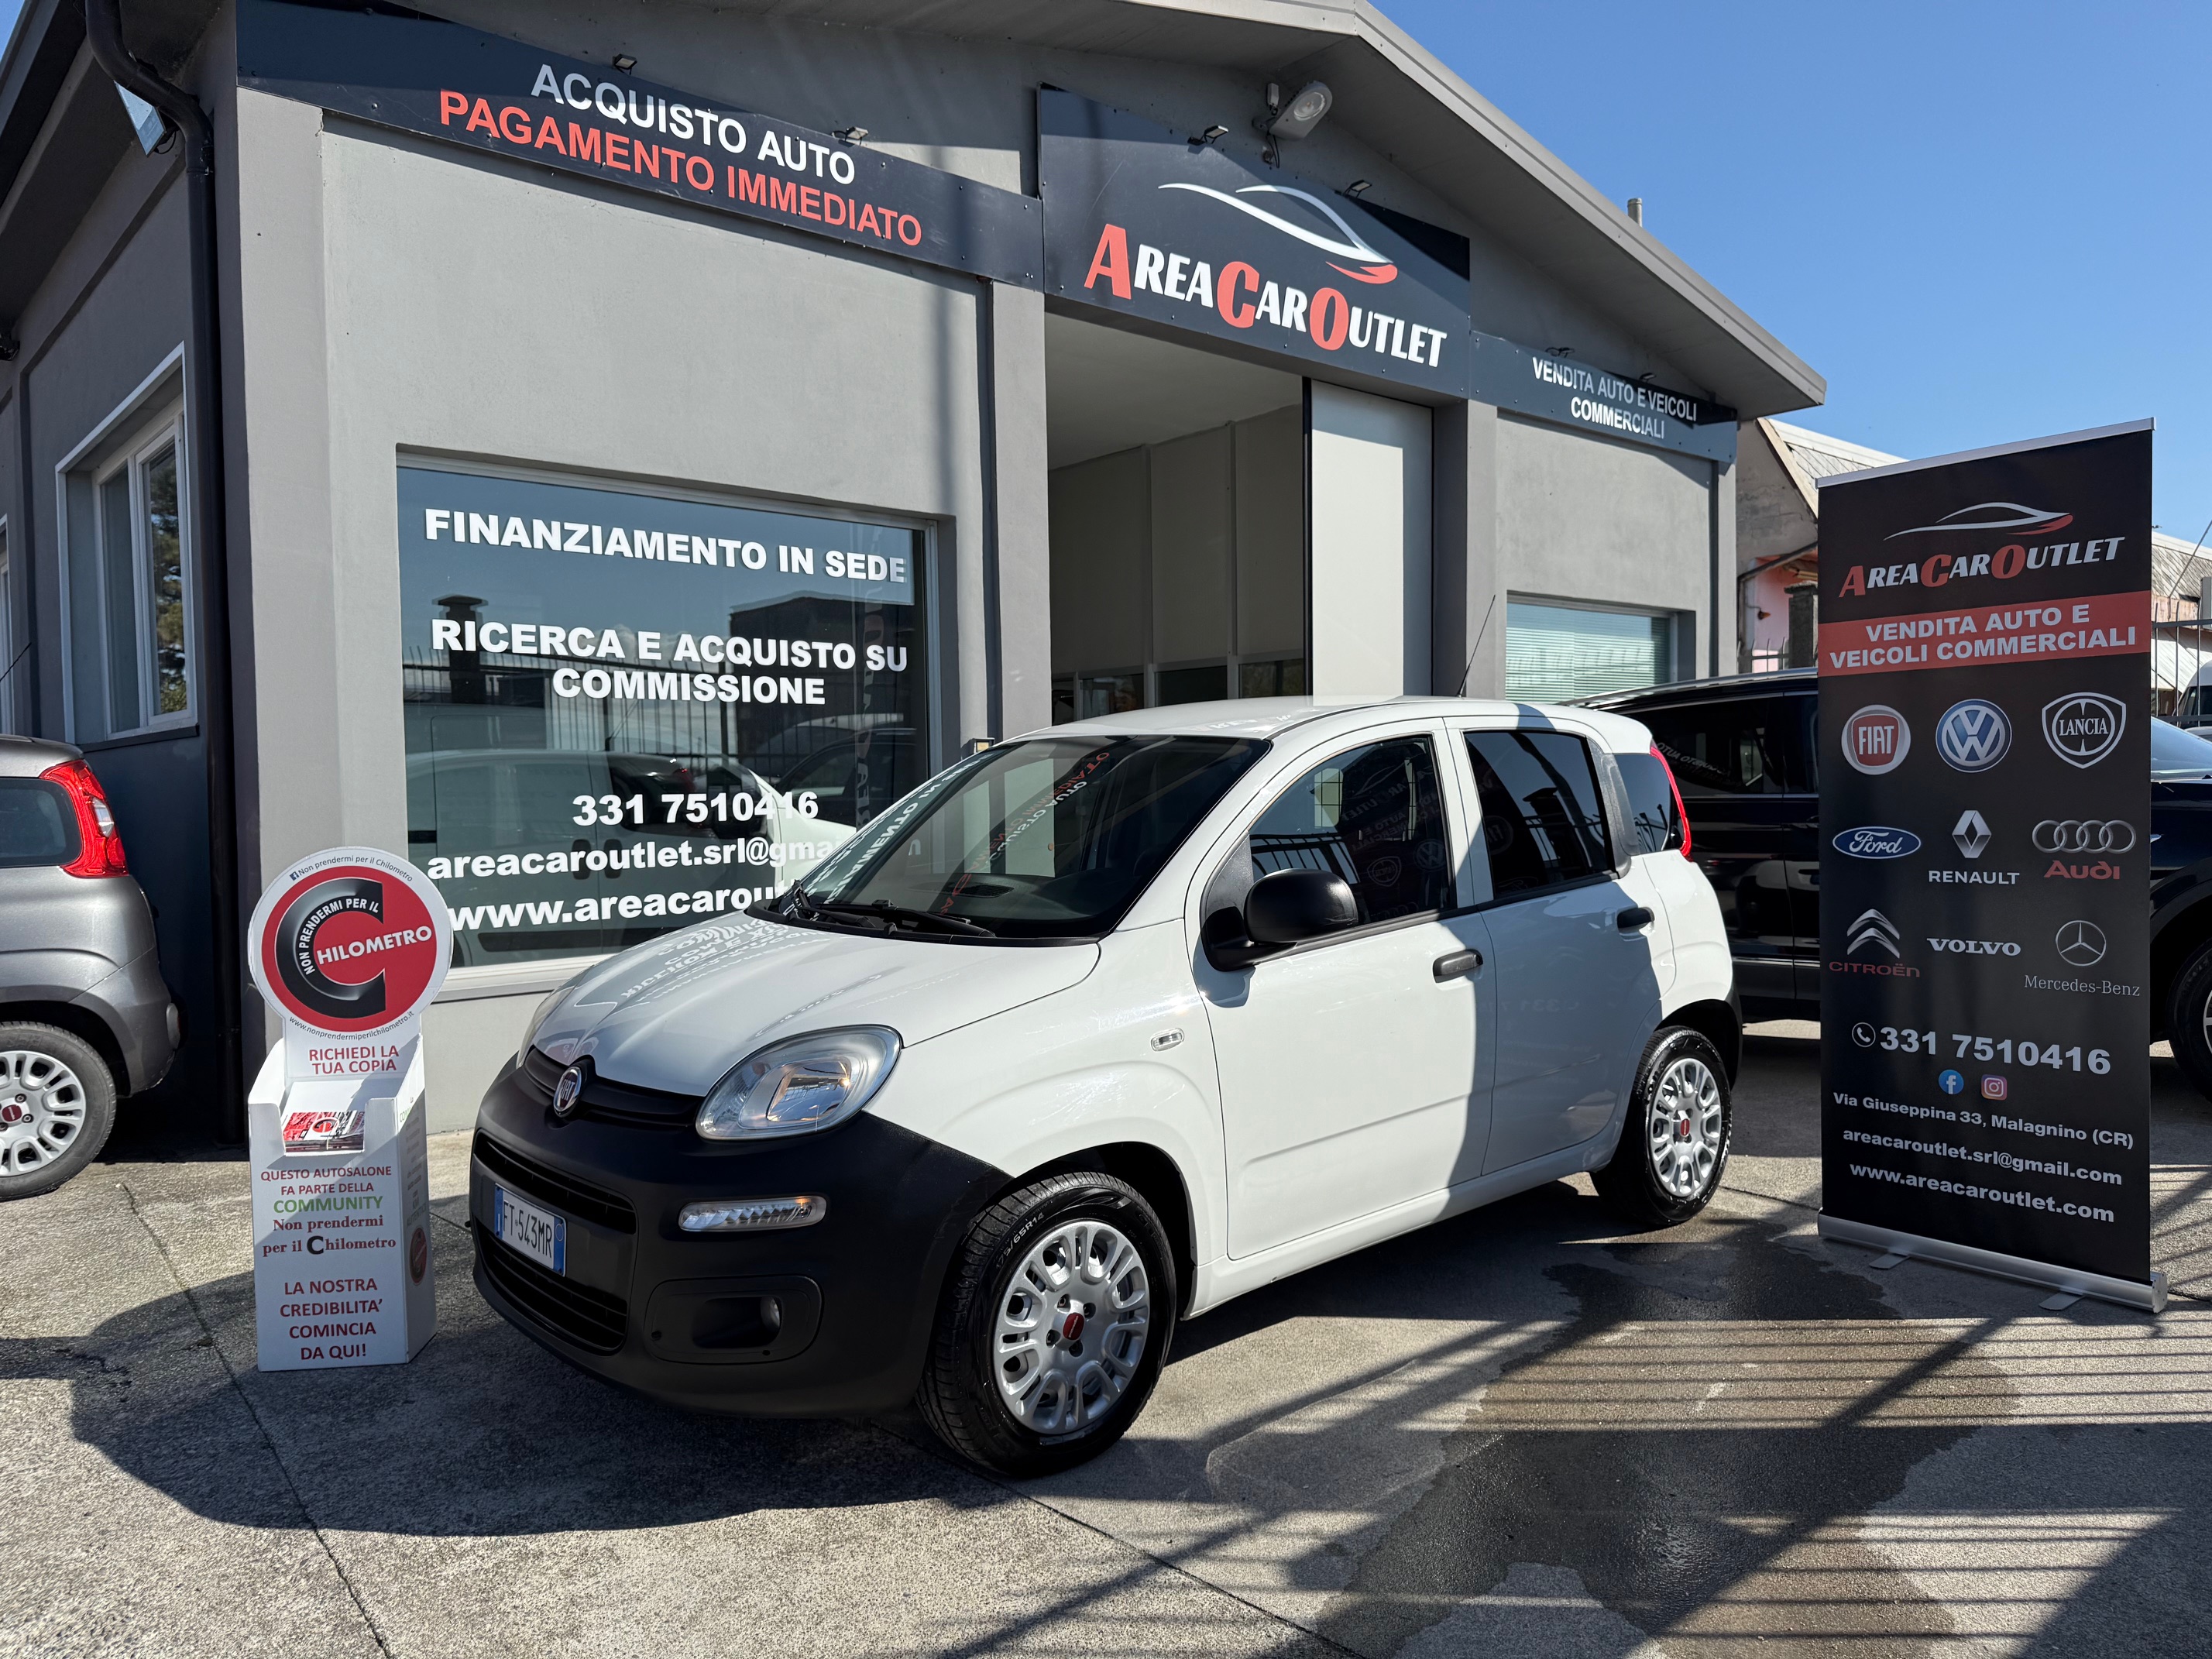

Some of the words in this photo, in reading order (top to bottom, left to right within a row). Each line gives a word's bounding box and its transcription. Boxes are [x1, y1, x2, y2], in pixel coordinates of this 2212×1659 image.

[531, 64, 747, 154] ACQUISTO
[757, 130, 855, 185] AUTO
[440, 88, 715, 191] PAGAMENTO
[726, 165, 922, 246] IMMEDIATO
[1532, 356, 1594, 394] VENDITA
[1597, 376, 1634, 404] AUTO
[1637, 387, 1647, 408] E
[1647, 390, 1697, 422] VEICOLI
[1571, 397, 1664, 439] COMMERCIALI
[424, 508, 768, 571] FINANZIAMENTO
[778, 544, 815, 575] IN
[824, 549, 907, 584] SEDE
[1866, 616, 1977, 642] VENDITA
[1985, 607, 2062, 632] AUTO
[2073, 604, 2090, 624] E
[431, 619, 626, 659] RICERCA
[637, 630, 662, 661] E
[673, 634, 856, 670] ACQUISTO
[865, 646, 908, 673] SU
[1829, 644, 1927, 669] VEICOLI
[1936, 626, 2136, 661] COMMERCIALI
[551, 668, 826, 706] COMMISSIONE
[2059, 717, 2109, 737] LANCIA
[1858, 725, 1894, 755] FIAT
[572, 794, 645, 827] 331
[660, 791, 819, 824] 7510416
[1849, 830, 1904, 854] Ford
[298, 864, 314, 876] Non
[314, 855, 354, 869] prendermi
[376, 859, 413, 882] Chilometro
[1929, 870, 2020, 885] RENAULT
[2043, 860, 2121, 880] Audi
[345, 898, 366, 909] PER
[369, 901, 380, 914] IL
[299, 899, 343, 949] PRENDERMI
[1927, 937, 2021, 957] VOLVO
[299, 952, 316, 975] NON
[2025, 975, 2141, 997] Mercedes-Benz
[289, 1010, 415, 1041] www.nonprendermiperilchilometro.it
[309, 1047, 375, 1062] RICHIEDI
[380, 1045, 399, 1057] LA
[1880, 1026, 1936, 1055] 331
[1952, 1034, 2111, 1075] 7510416
[312, 1062, 345, 1075] TUA
[349, 1059, 397, 1073] COPIA
[1833, 1092, 1858, 1107] Via
[1863, 1097, 1956, 1122] Giuseppina
[1960, 1111, 1987, 1128] 33,
[1991, 1115, 2087, 1141] Malagnino
[2092, 1128, 2134, 1150] (CR)
[1843, 1128, 2122, 1186] areacaroutlet.srl@gmail.com
[260, 1169, 310, 1182] QUESTO
[313, 1166, 392, 1179] AUTOSALONE
[280, 1186, 295, 1196] FA
[298, 1183, 335, 1195] PARTE
[338, 1182, 374, 1193] DELLA
[1850, 1163, 2114, 1223] www.areacaroutlet.com
[273, 1195, 383, 1214] COMMUNITY
[273, 1219, 303, 1231] Non
[307, 1214, 384, 1233] prendermi
[262, 1243, 288, 1258] per
[291, 1240, 303, 1253] il
[306, 1235, 397, 1255] Chilometro
[284, 1282, 304, 1296] LA
[309, 1277, 378, 1294] NOSTRA
[289, 1321, 376, 1339] COMINCIA
[301, 1346, 323, 1361] DA
[328, 1343, 366, 1359] QUI!
